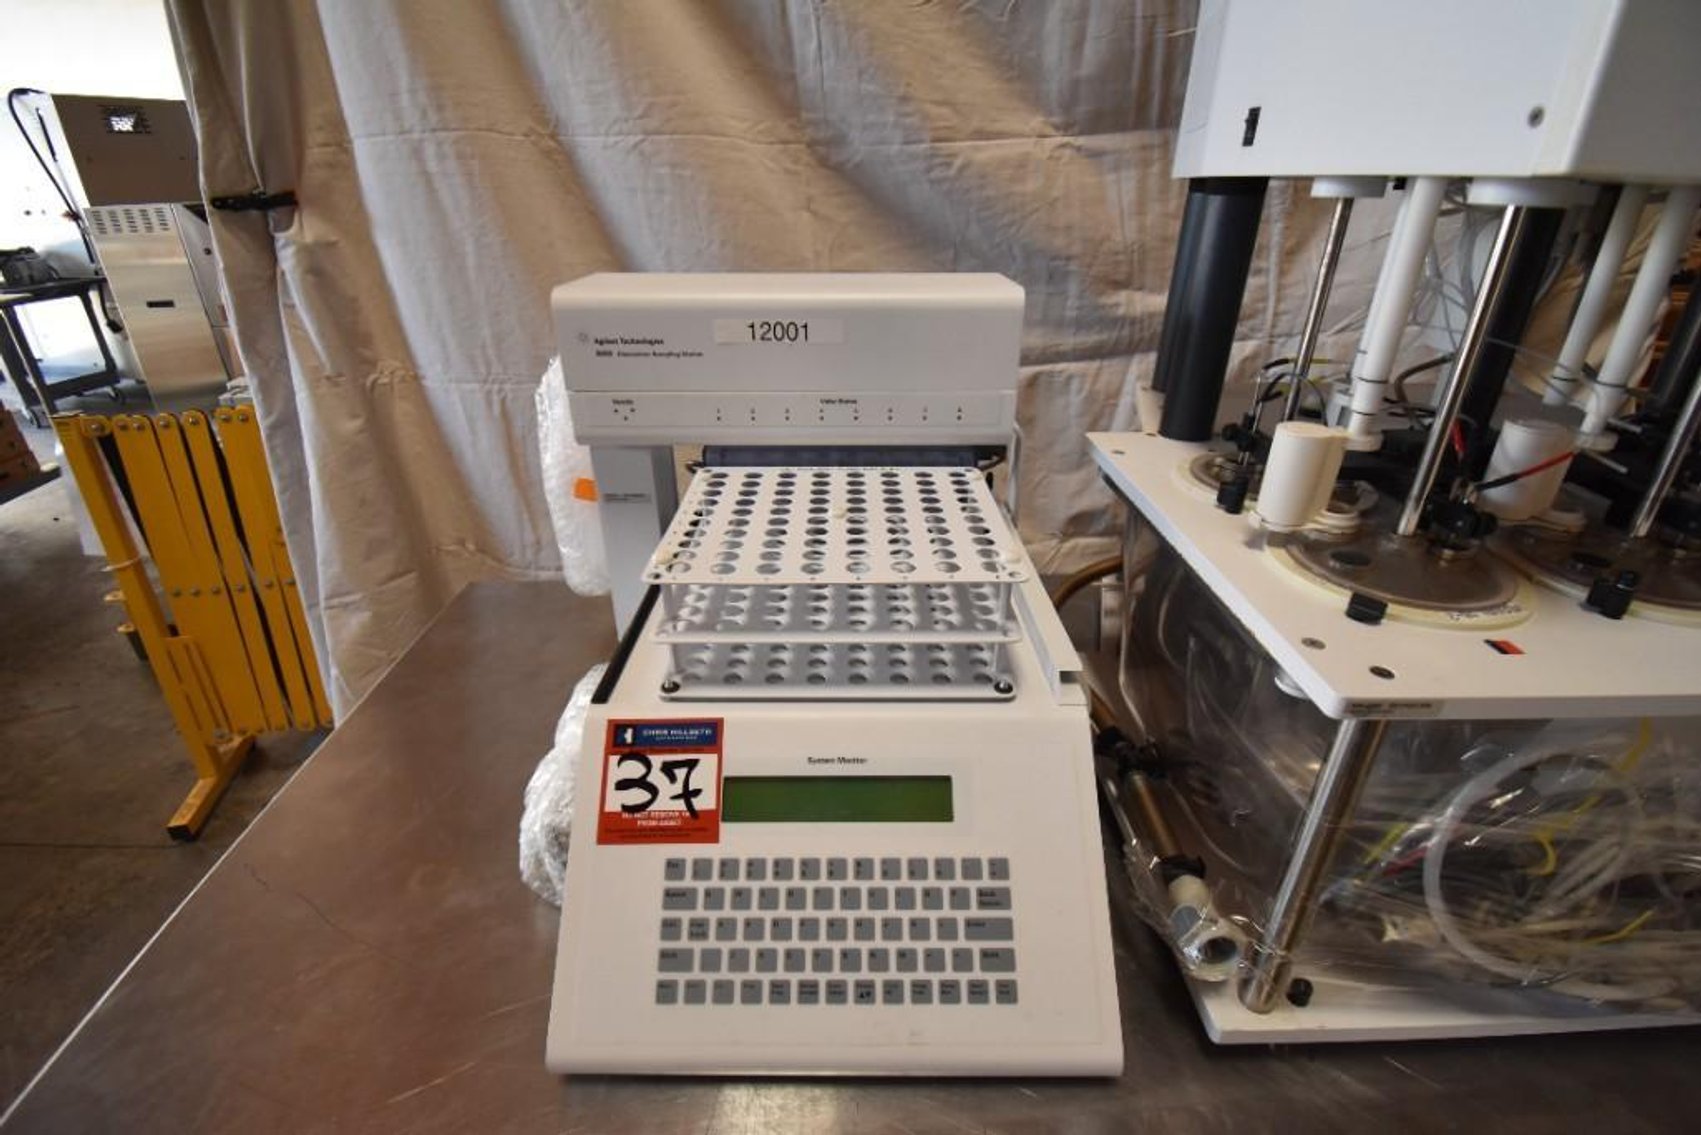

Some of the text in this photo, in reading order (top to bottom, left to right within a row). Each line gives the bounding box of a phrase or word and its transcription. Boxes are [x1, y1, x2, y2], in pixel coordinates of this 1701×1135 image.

[747, 321, 808, 342] 12001
[594, 335, 664, 346] Agilent Technologies
[807, 756, 868, 765] System Monitor
[614, 752, 703, 820] 37
